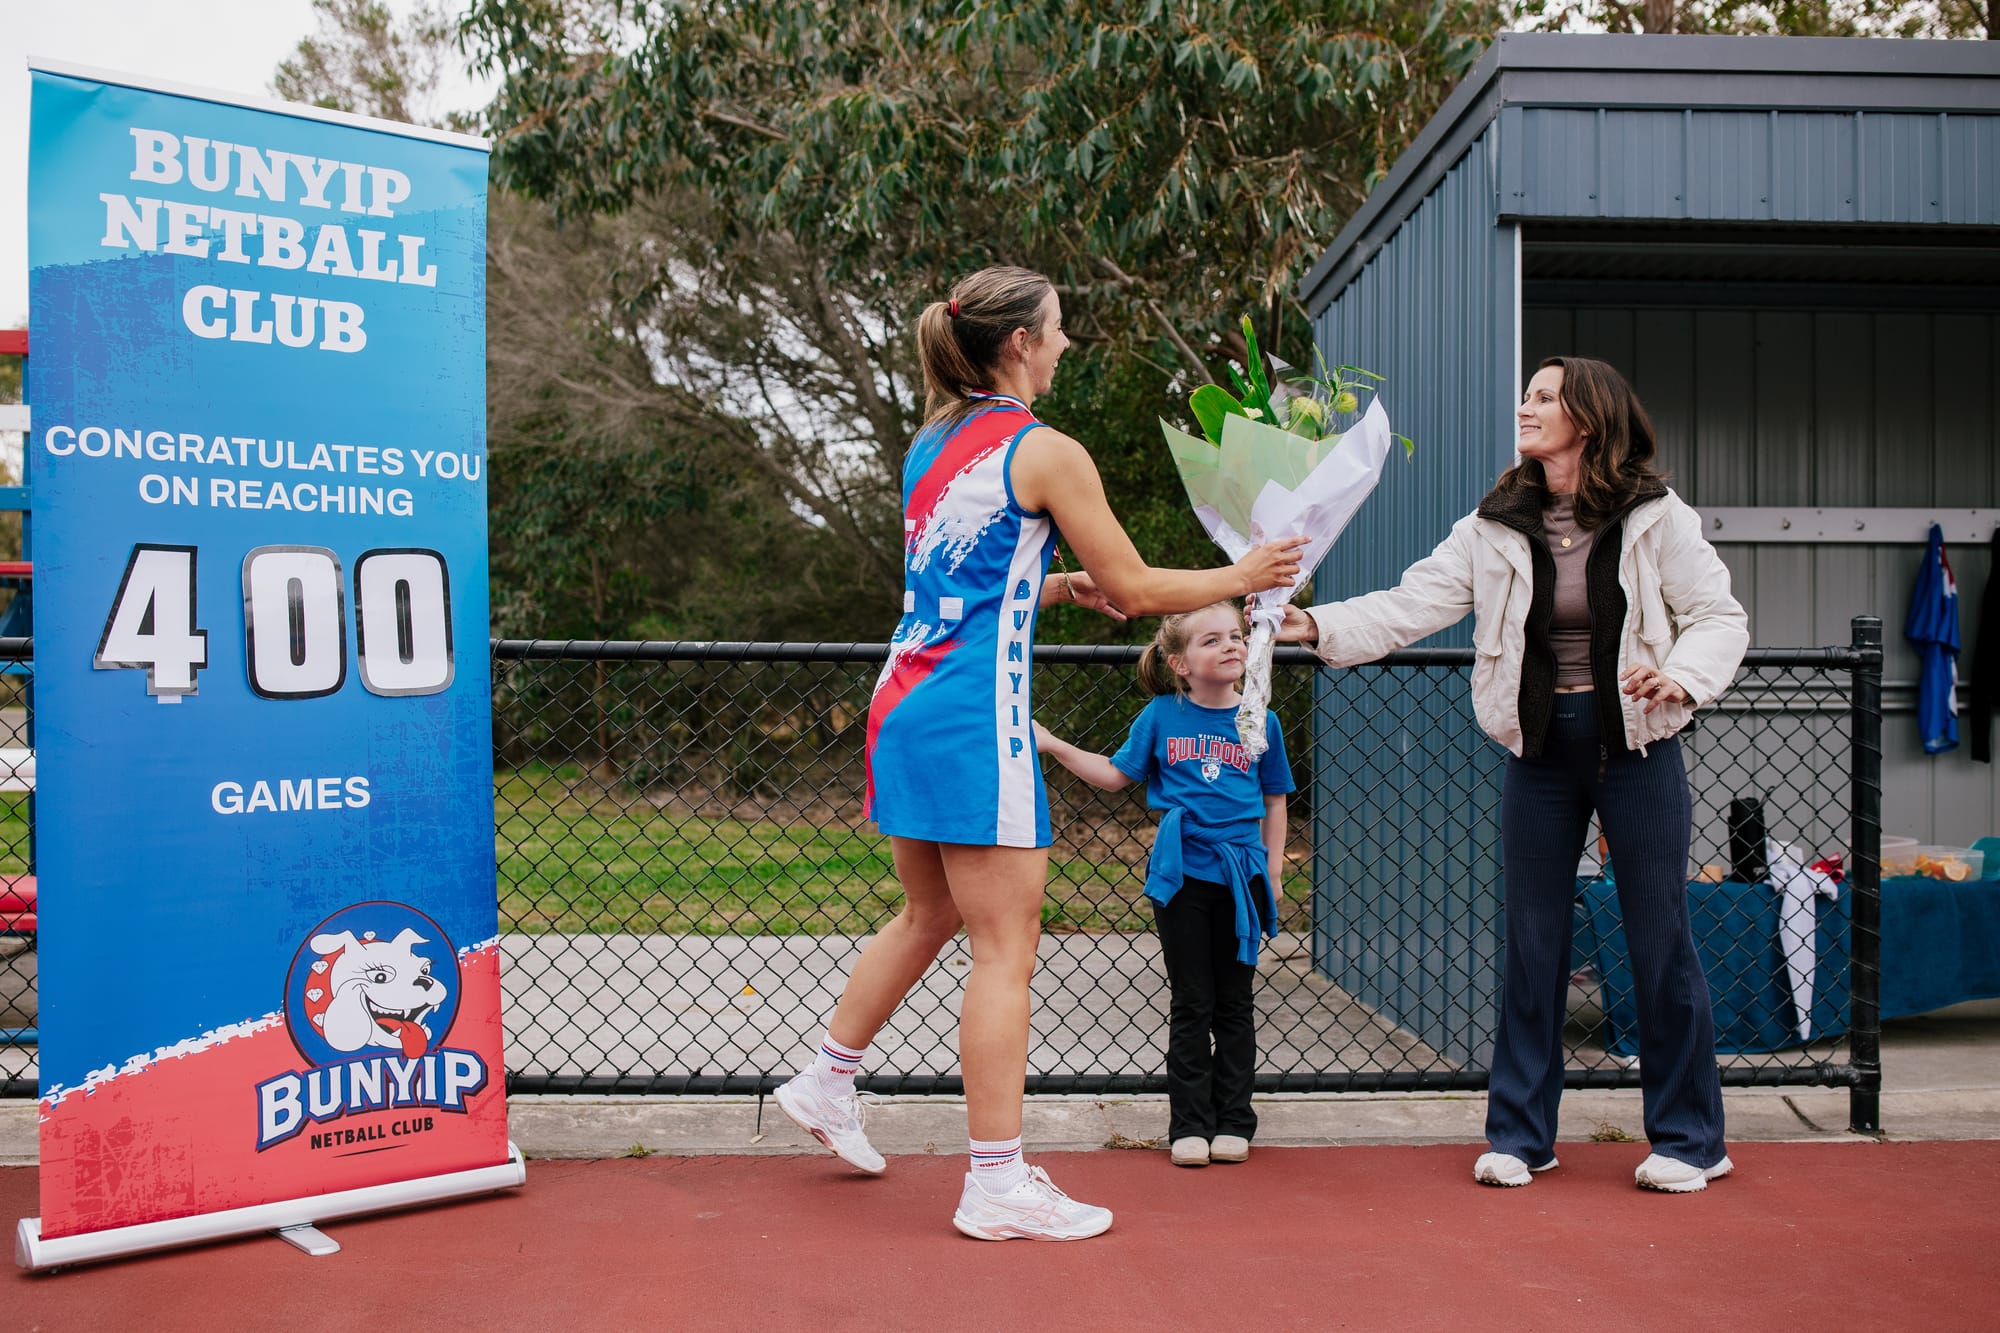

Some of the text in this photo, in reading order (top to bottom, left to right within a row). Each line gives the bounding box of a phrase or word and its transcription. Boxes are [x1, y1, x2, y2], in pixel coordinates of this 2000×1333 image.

[129, 127, 411, 218] BUNYIP
[99, 193, 438, 287] NETBALL
[182, 285, 368, 353] CLUB
[45, 425, 481, 481] CONGRATULATES YOU
[138, 474, 414, 517] ON REACHING
[93, 543, 456, 701] 400
[1007, 579, 1031, 758] BUNYIP
[1167, 737, 1251, 774] BULLDOGS
[211, 776, 371, 815] GAMES
[258, 1049, 484, 1148] BUNYIP
[310, 1117, 434, 1150] NETBALL CLUB
